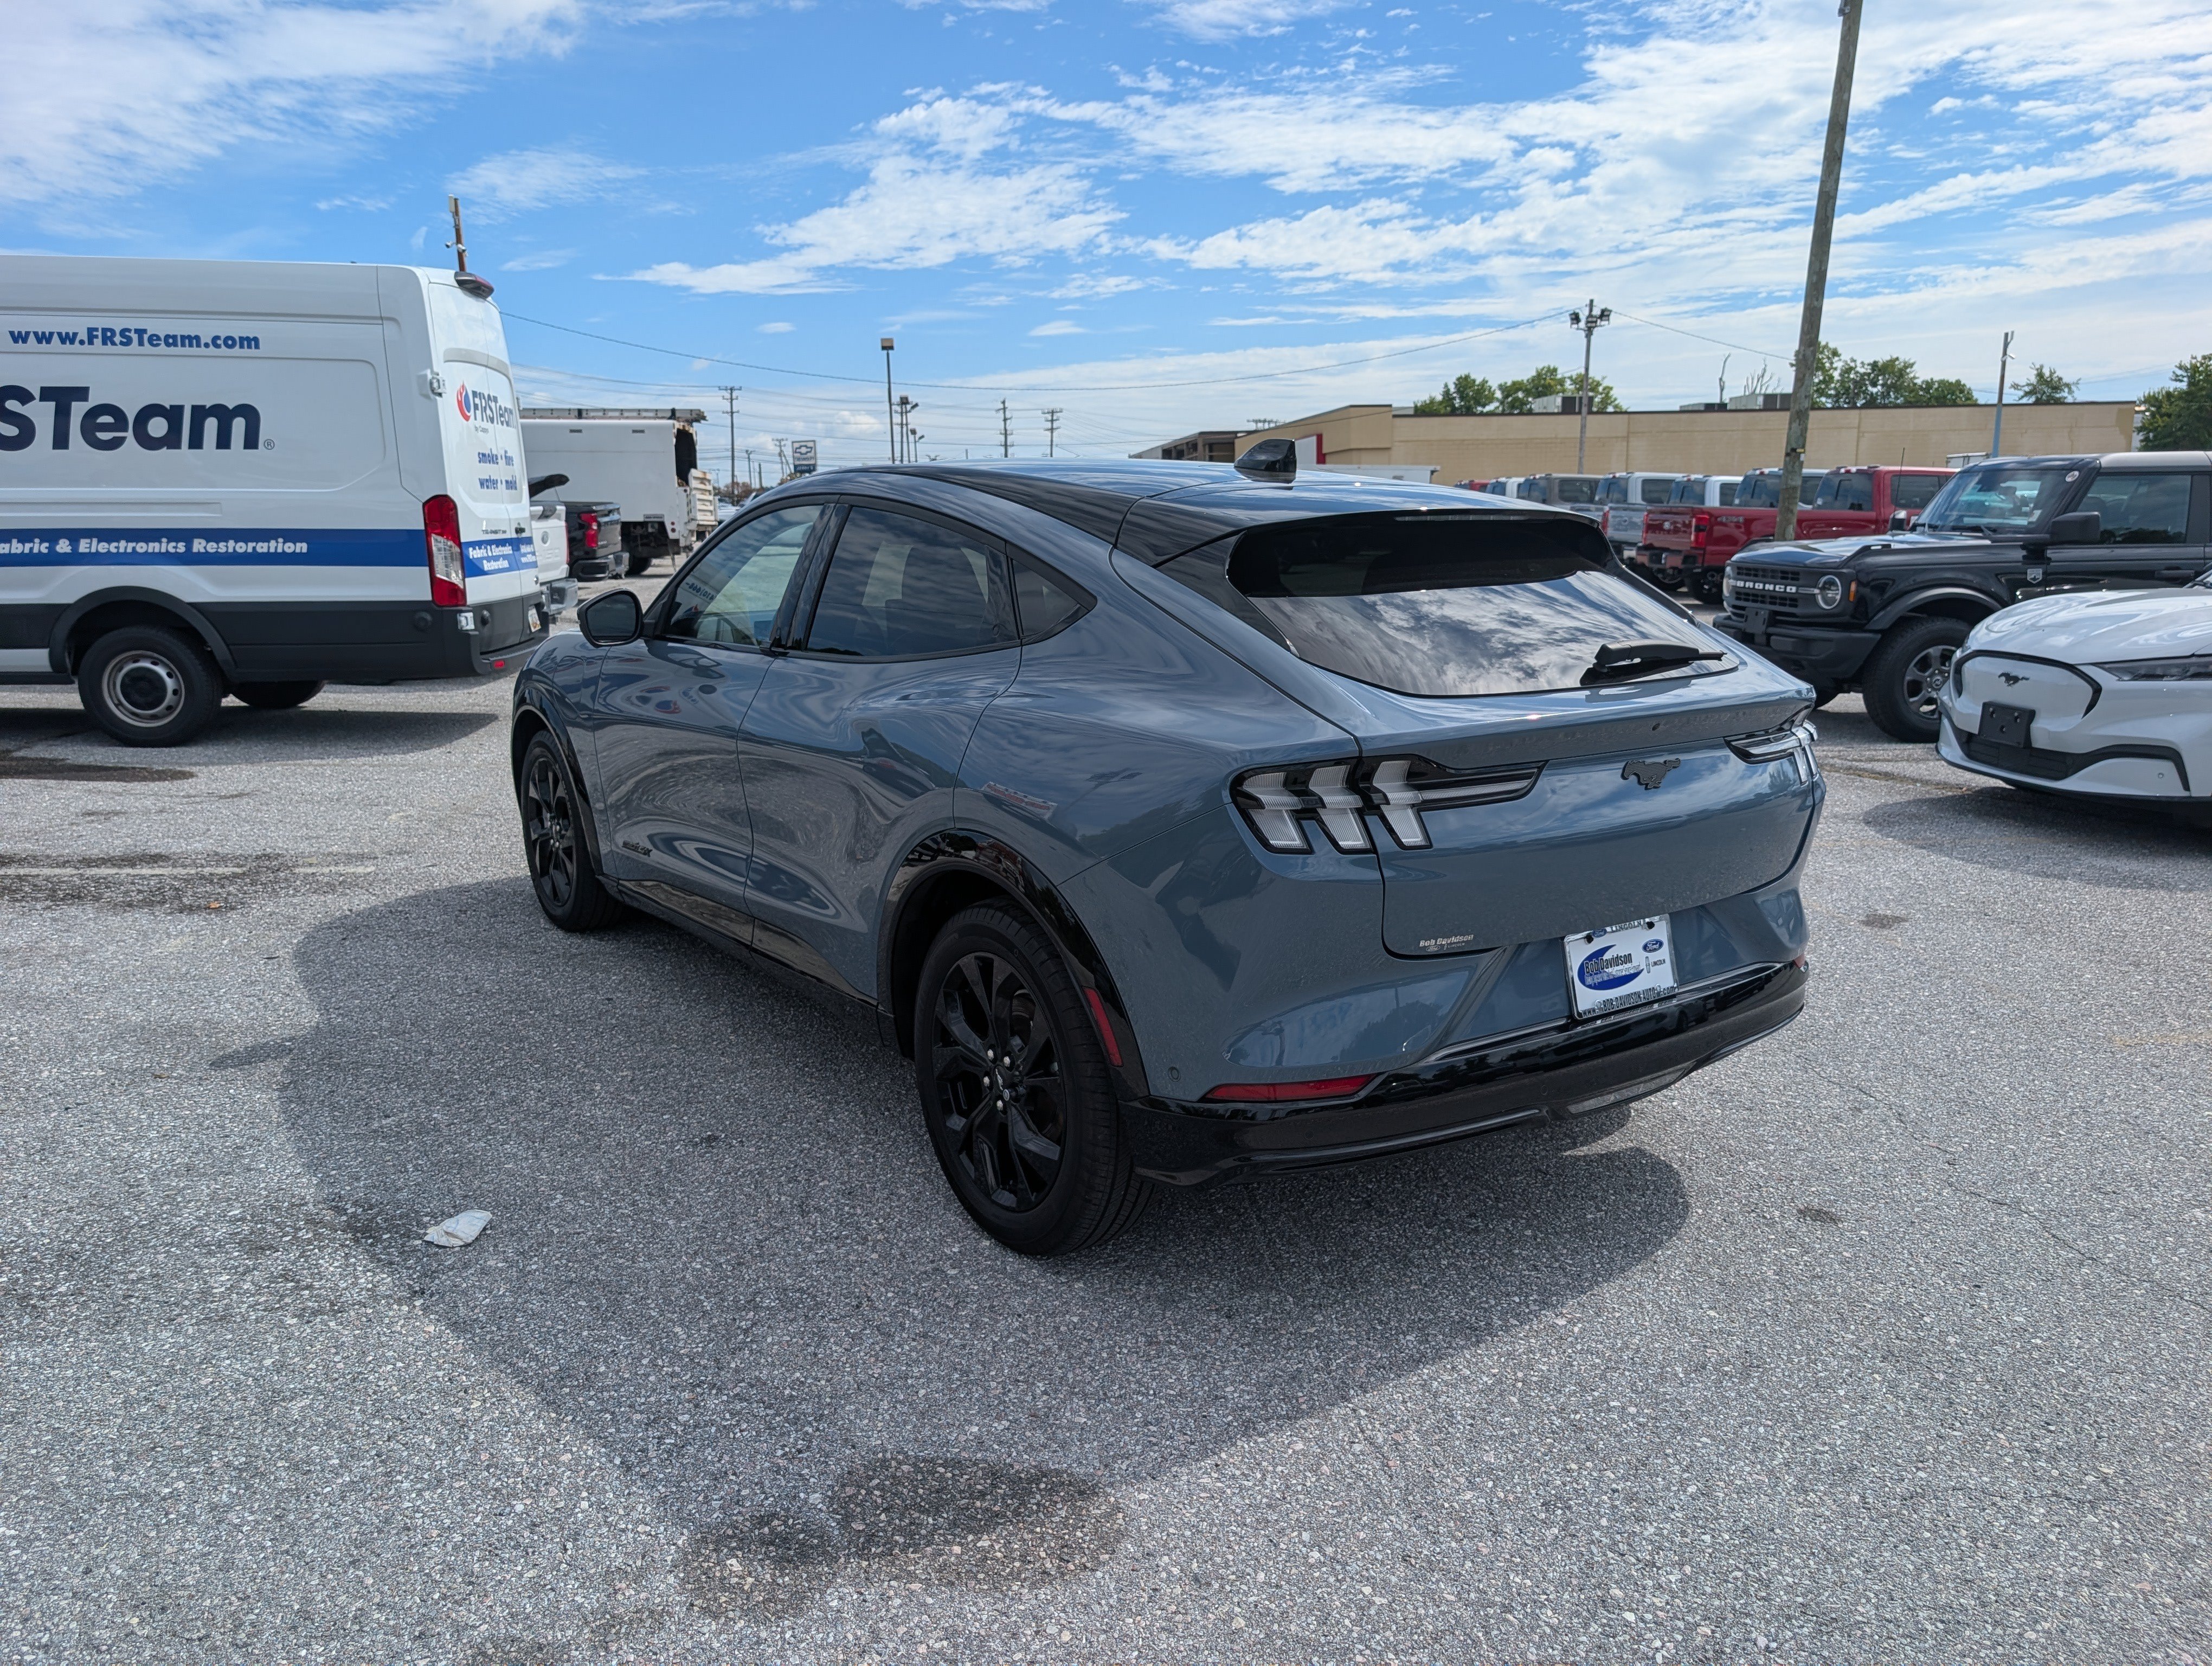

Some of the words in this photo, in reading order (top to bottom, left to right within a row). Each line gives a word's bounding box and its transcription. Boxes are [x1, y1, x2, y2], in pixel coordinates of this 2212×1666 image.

[8, 327, 261, 350] www.FRSTeam.com
[472, 390, 516, 429] FRSTeam
[478, 447, 499, 465] smoke
[504, 449, 514, 466] fire
[478, 475, 499, 490] water
[505, 475, 517, 490] mold
[55, 539, 72, 553] &
[79, 537, 186, 553] Electronics
[192, 538, 308, 554] Restoration
[469, 544, 487, 559] Fabric
[487, 545, 492, 556] &
[492, 543, 513, 555] Electronics
[483, 556, 510, 571] Restoration
[1736, 580, 1797, 593] BRONCO
[1611, 920, 1642, 933] LINCOLN
[1419, 939, 1435, 947] Bob
[1437, 934, 1474, 944] Davidson
[1645, 940, 1661, 952] Ford
[1585, 957, 1599, 975] Bob
[1599, 952, 1633, 970] Davidson
[1651, 958, 1666, 967] LINCOLN
